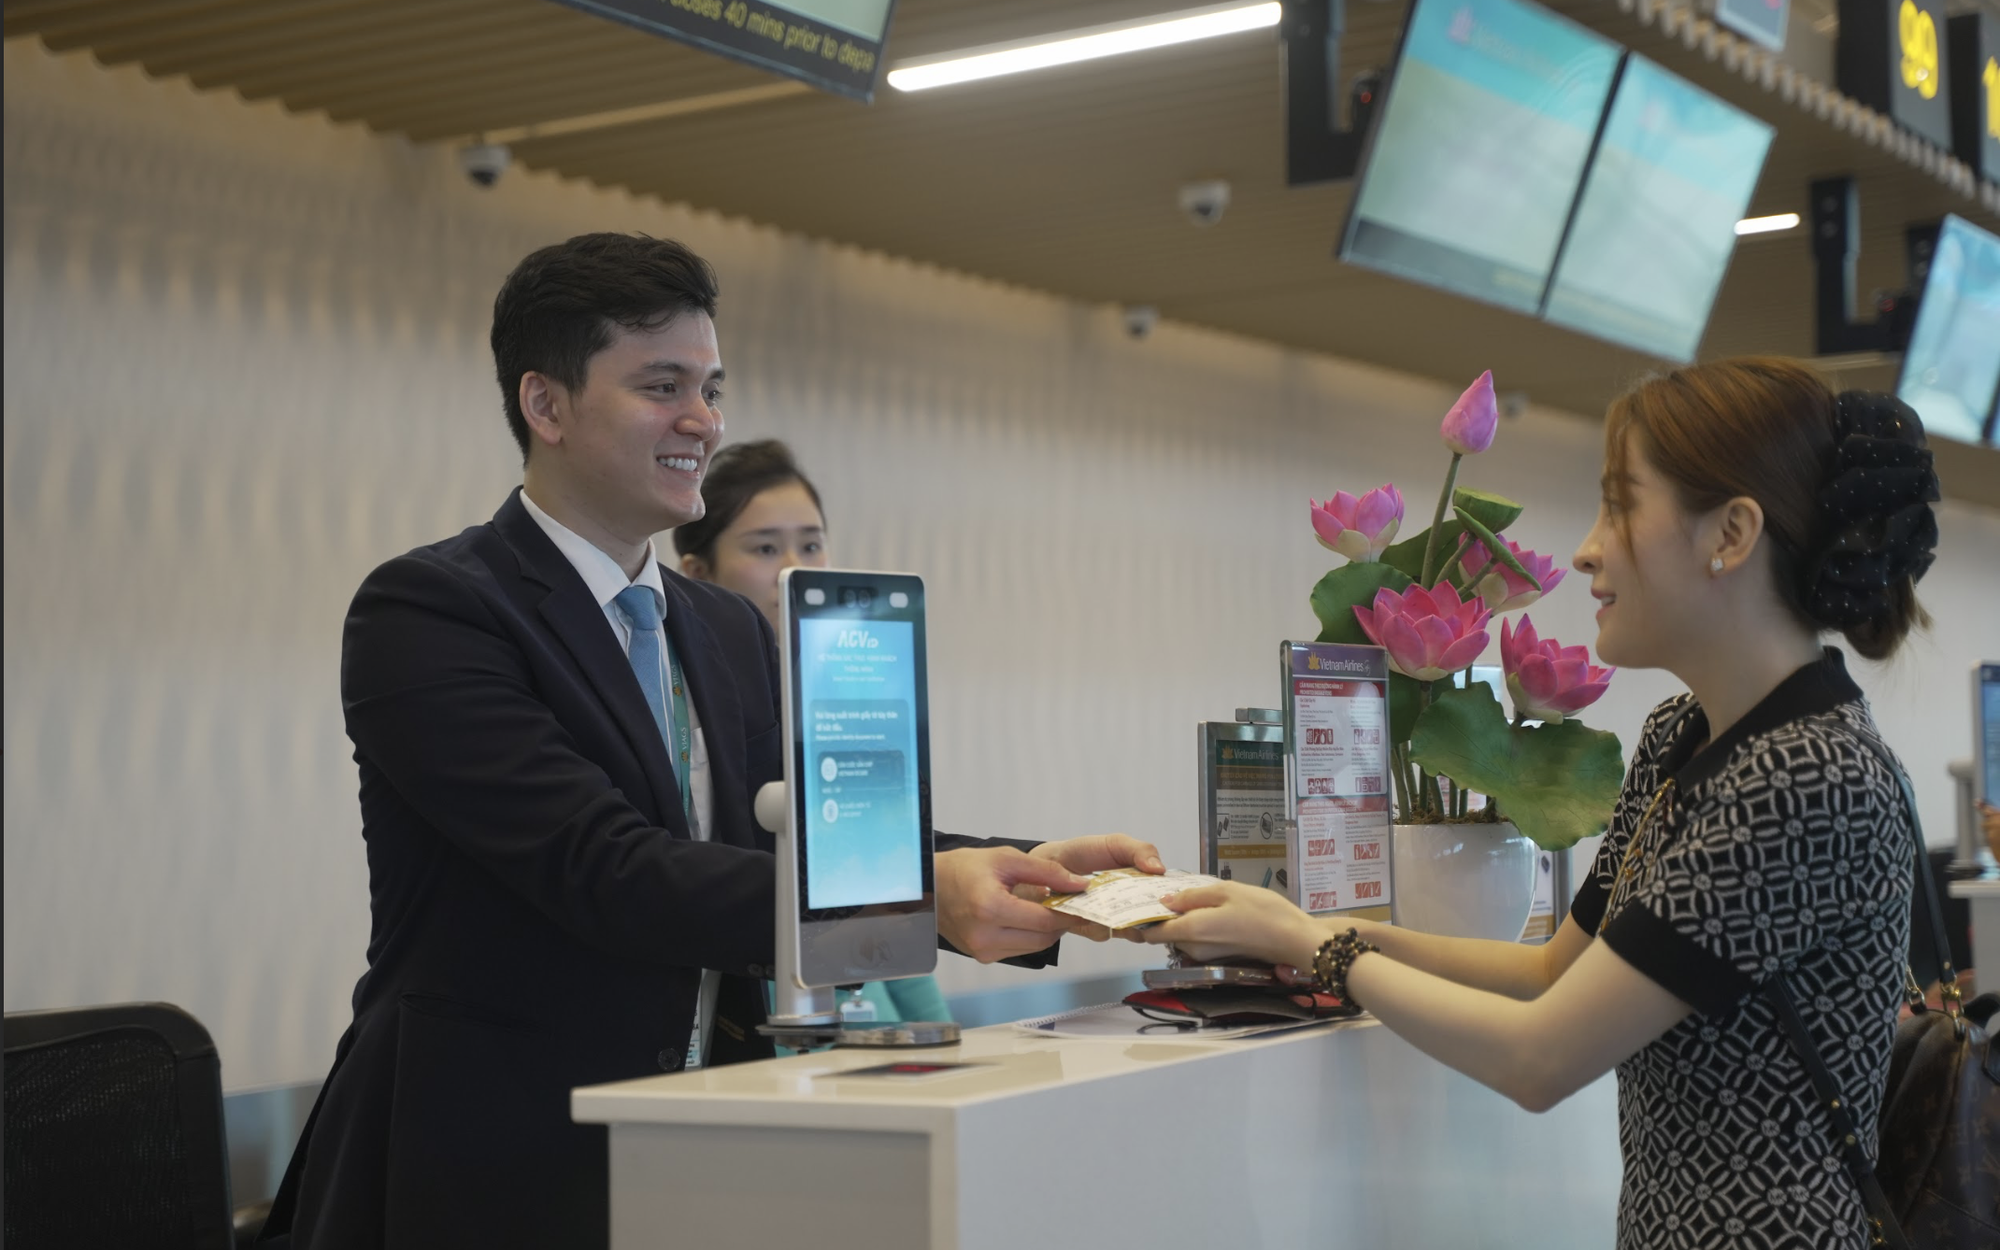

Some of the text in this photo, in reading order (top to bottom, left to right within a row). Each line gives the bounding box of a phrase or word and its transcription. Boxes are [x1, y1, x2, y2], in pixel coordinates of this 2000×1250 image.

[724, 1, 748, 28] 40
[746, 11, 786, 41] mins
[783, 25, 822, 52] prior
[821, 33, 838, 60] to
[1899, 0, 1939, 100] 99
[1982, 55, 2000, 143] 1
[1320, 658, 1364, 672] Vietnam Airlines
[1234, 748, 1279, 761] Vietnam Airlines
